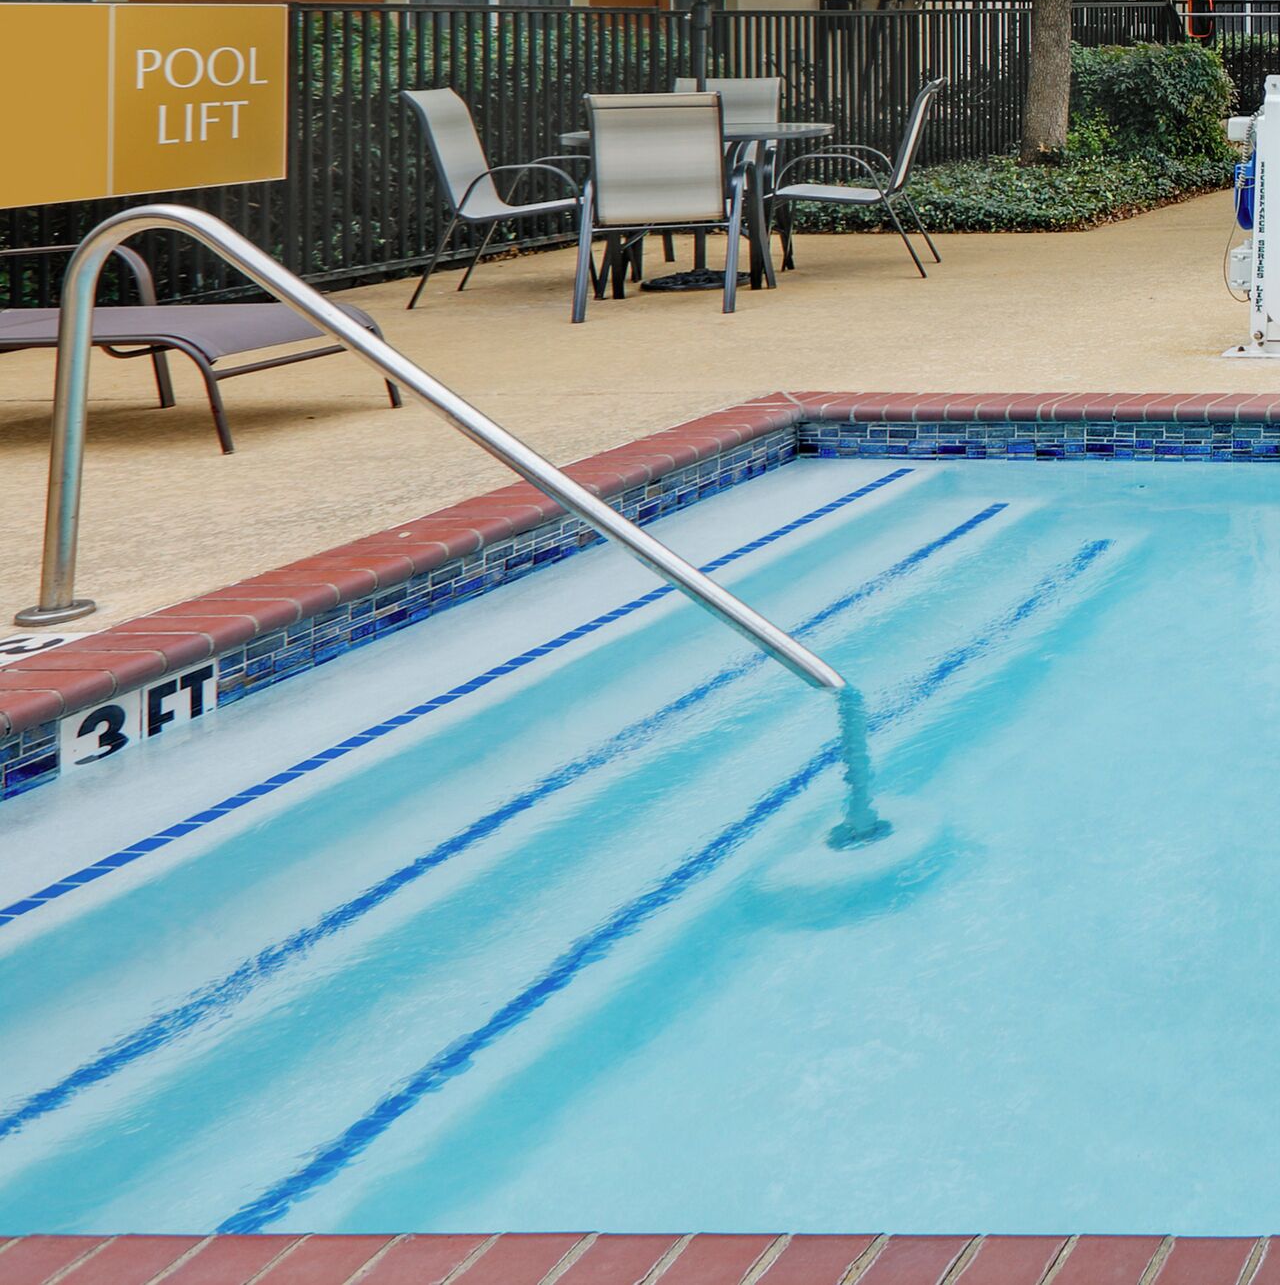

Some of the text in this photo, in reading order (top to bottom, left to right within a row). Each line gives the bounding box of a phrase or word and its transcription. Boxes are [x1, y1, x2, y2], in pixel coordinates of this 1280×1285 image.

[136, 47, 269, 89] POOL
[158, 100, 249, 144] LIFT
[1257, 239, 1265, 279] SERIES
[1255, 285, 1264, 313] LIFT
[74, 664, 214, 765] 3 FT
